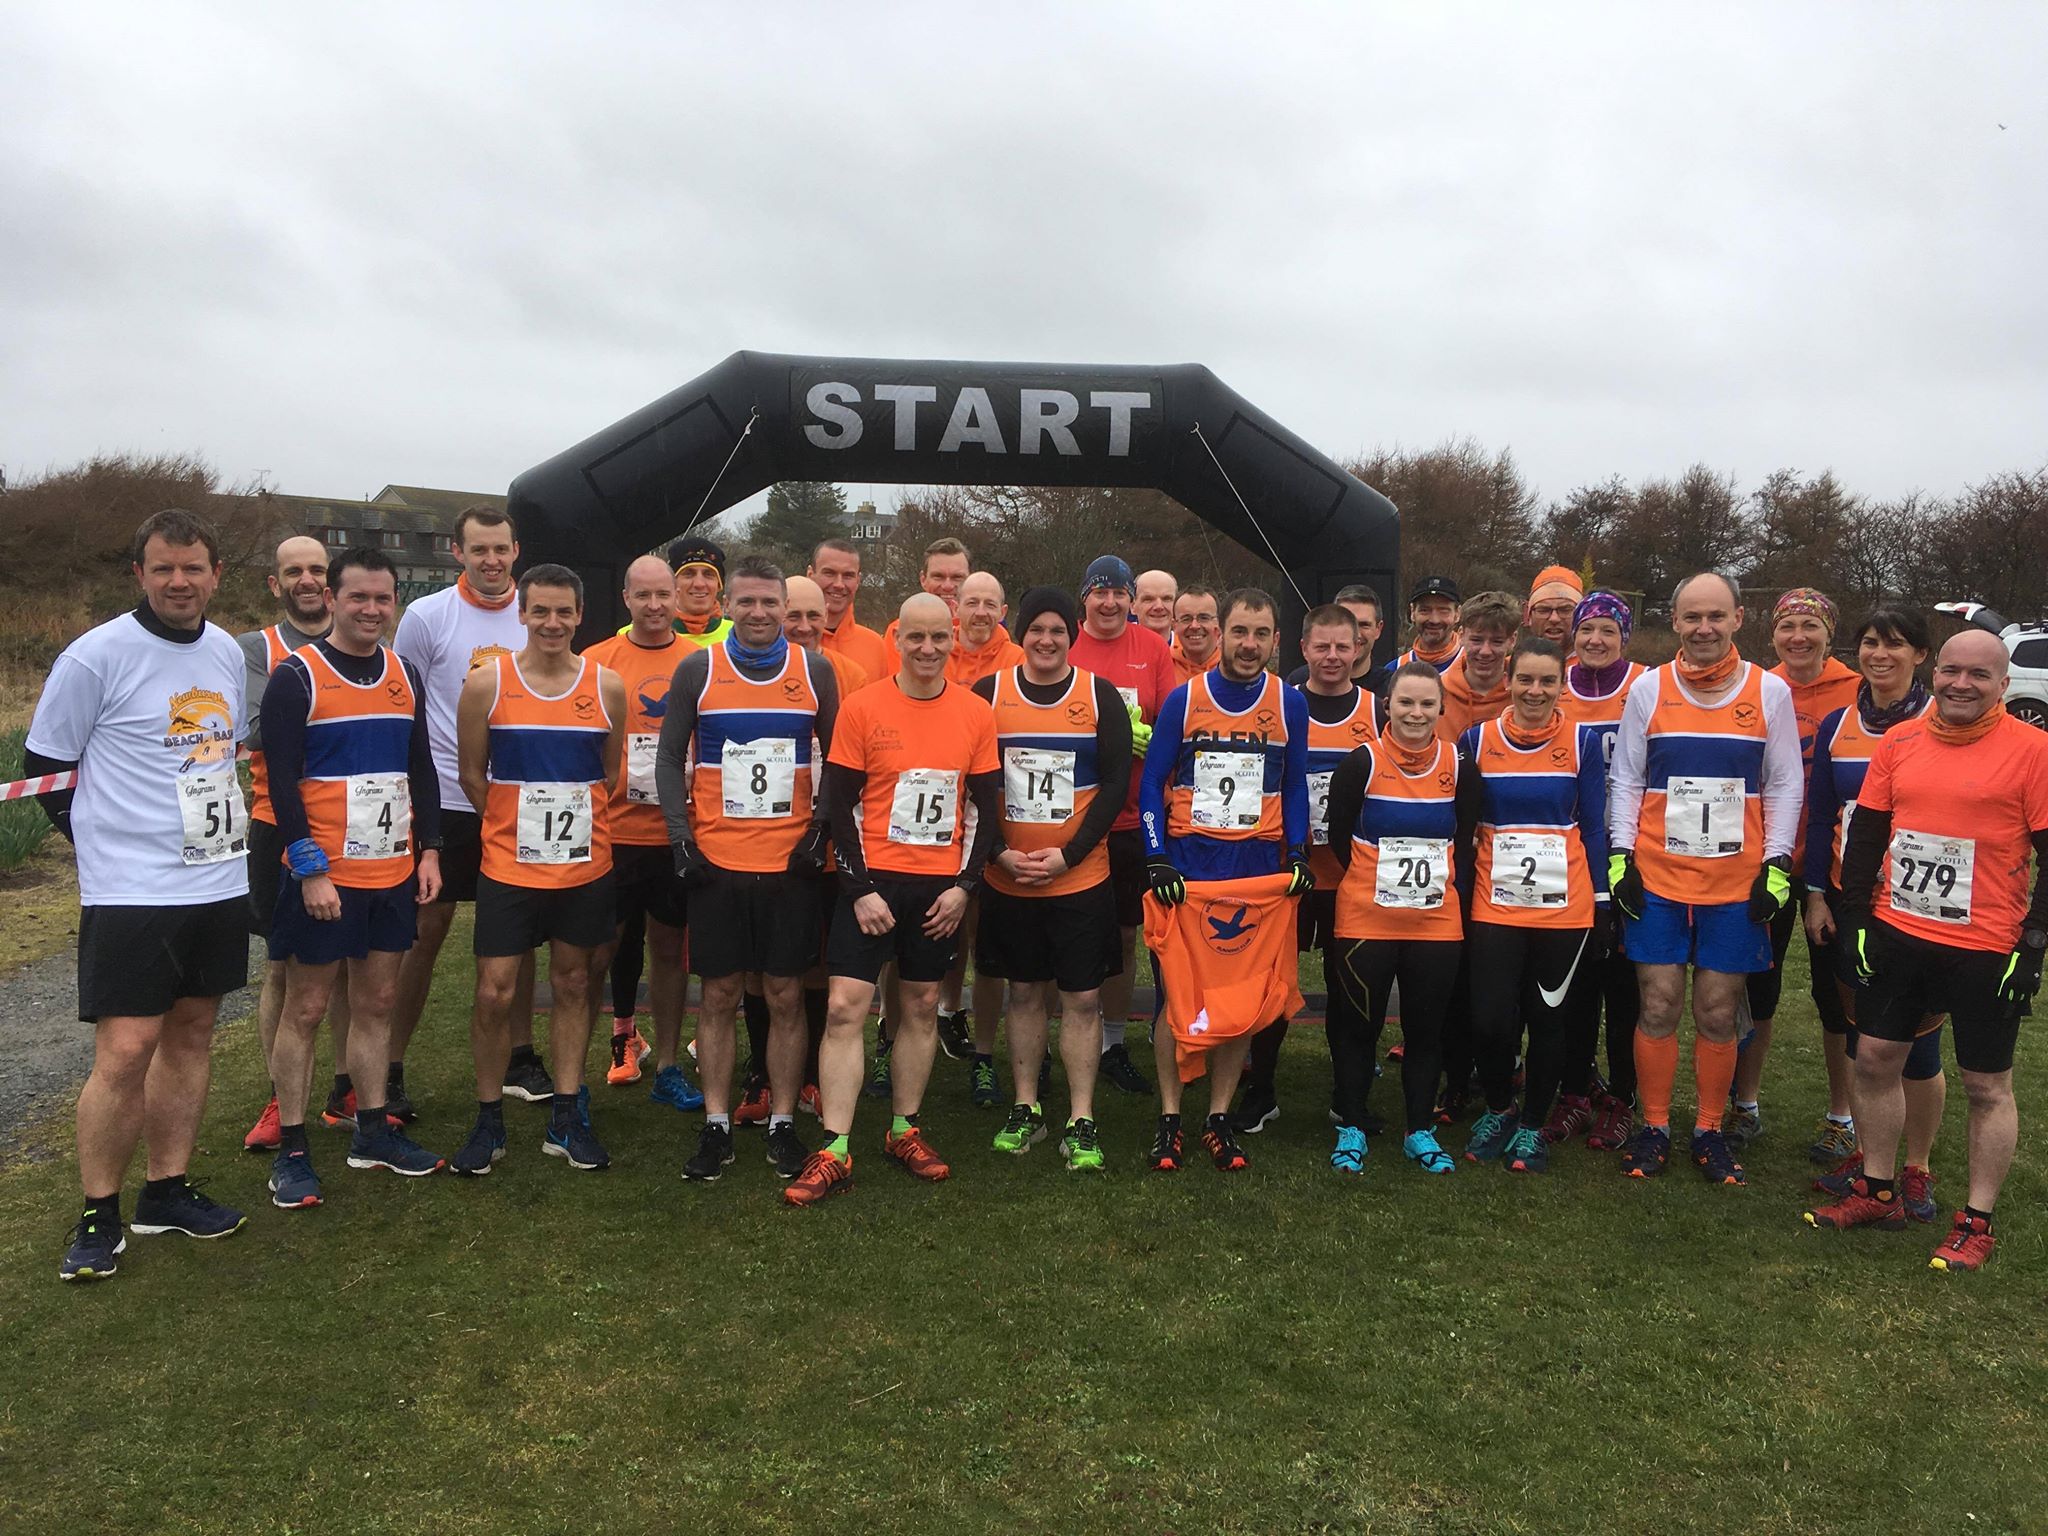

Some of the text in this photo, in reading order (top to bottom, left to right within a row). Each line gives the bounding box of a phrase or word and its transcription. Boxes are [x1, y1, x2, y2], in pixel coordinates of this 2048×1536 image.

[804, 382, 1150, 456] START
[163, 733, 204, 748] BEACH
[750, 763, 768, 795] 8
[1027, 772, 1055, 801] 14
[1218, 776, 1236, 806] 9
[915, 792, 945, 825] 15
[1713, 795, 1741, 803] SCOTIA
[204, 799, 232, 838] 51
[377, 802, 393, 835] 4
[544, 810, 575, 842] 12
[1702, 803, 1710, 834] 1
[1535, 850, 1564, 858] SCOTIA
[1934, 855, 1968, 866] SCOTIA
[1397, 857, 1431, 888] 20
[1520, 856, 1537, 886] 2
[1900, 856, 1957, 898] 279
